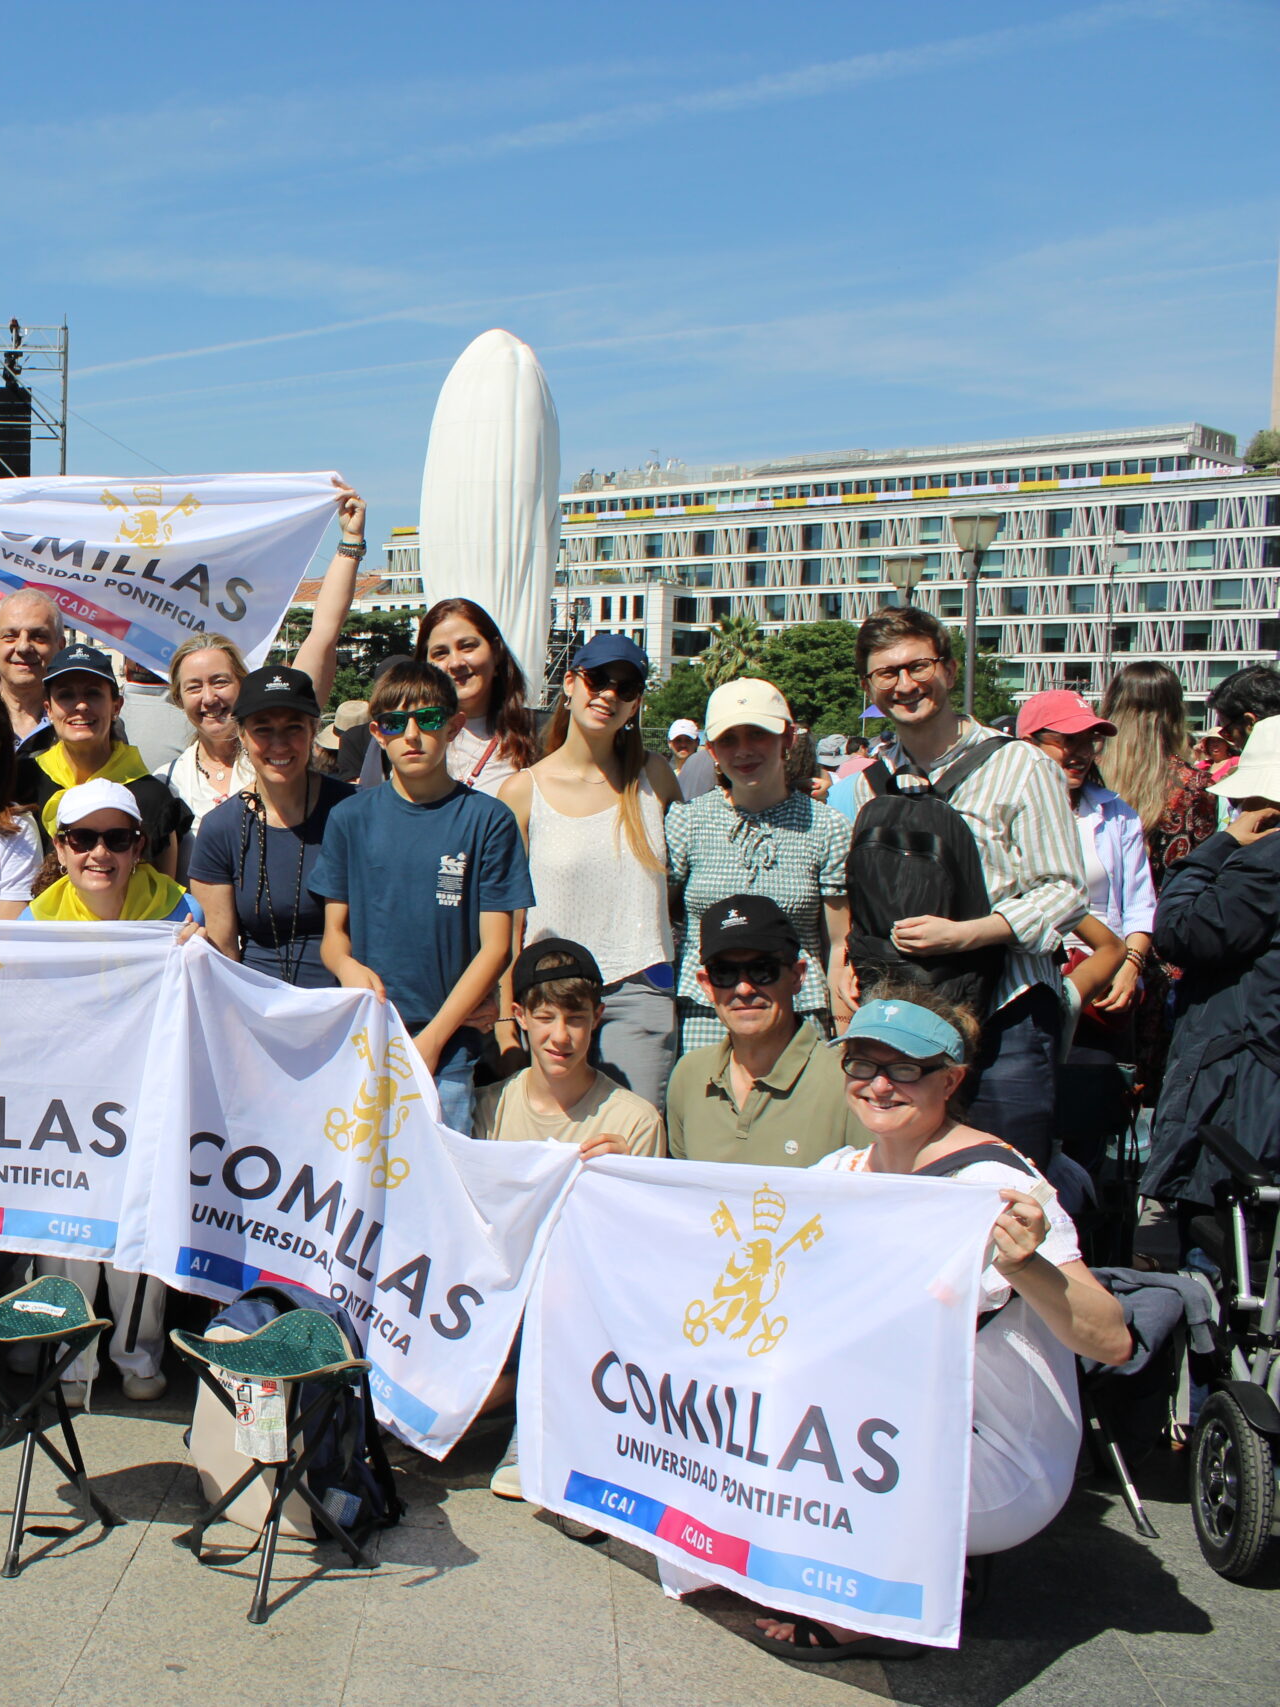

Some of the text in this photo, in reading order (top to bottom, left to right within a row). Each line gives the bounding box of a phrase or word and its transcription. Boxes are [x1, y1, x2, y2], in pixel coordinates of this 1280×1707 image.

[1, 530, 255, 622] MILLAS
[53, 591, 98, 621] ICADE
[104, 578, 206, 633] PONTIFICIA
[47, 1220, 92, 1239] CIHS
[189, 1131, 485, 1340] COMLLAS
[190, 1256, 211, 1272] AI
[191, 1203, 412, 1357] UNIVERSIDA ONTIFICIA
[368, 1369, 393, 1399] IHS
[592, 1351, 900, 1494] COMILLAS
[616, 1434, 854, 1535] UNIVERSIDAD PONTIFICIA
[600, 1488, 859, 1598] ICAI ICADE CIHS
